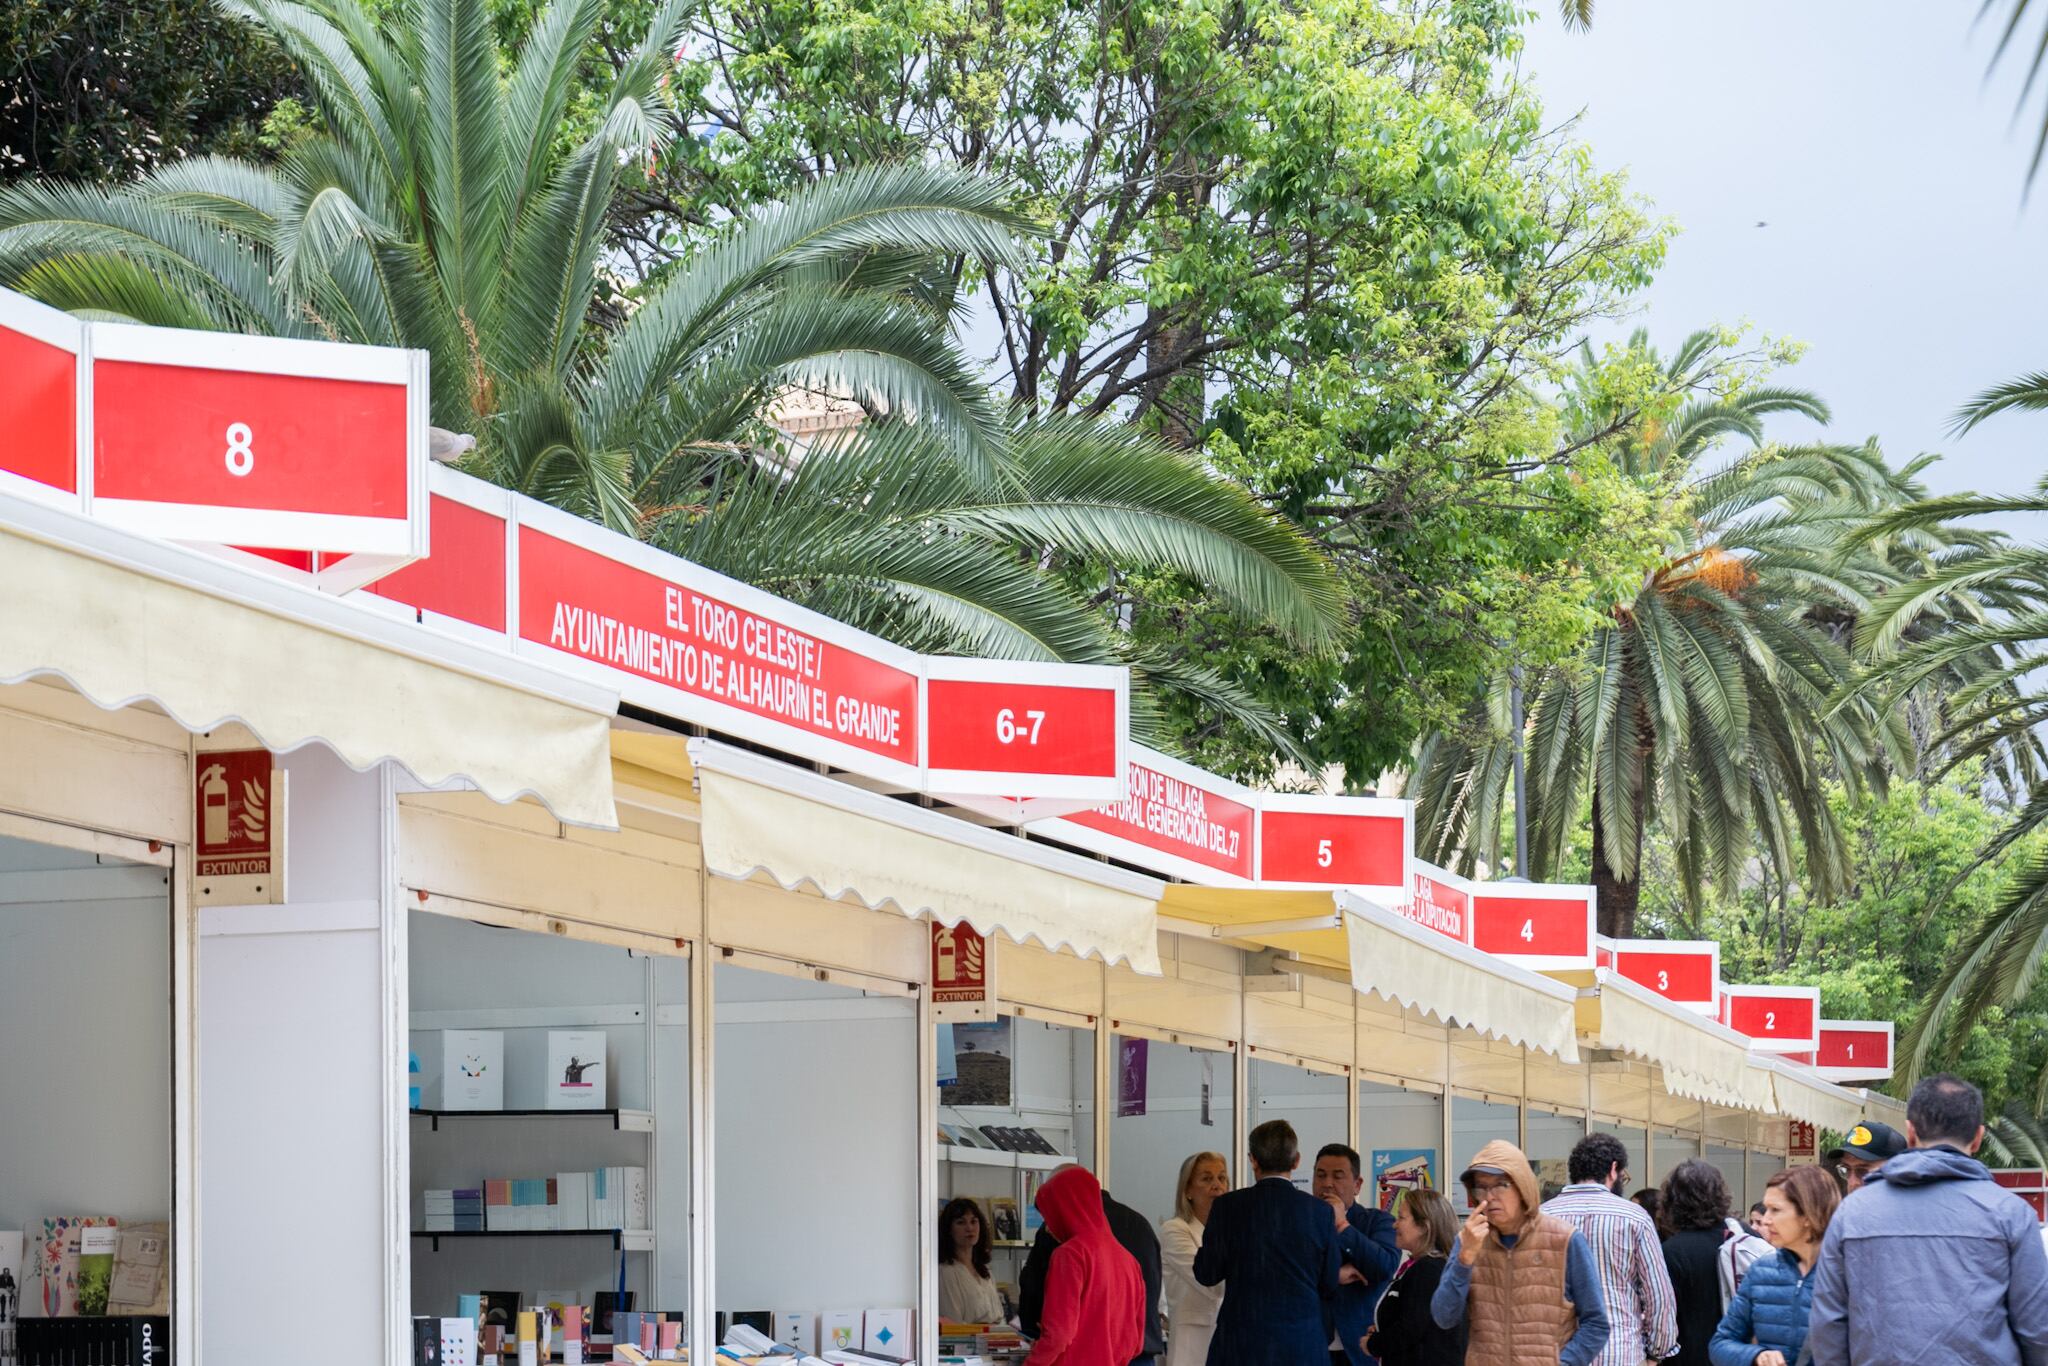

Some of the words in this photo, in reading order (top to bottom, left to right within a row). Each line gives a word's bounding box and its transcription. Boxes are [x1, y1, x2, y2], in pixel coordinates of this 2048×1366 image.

[225, 421, 254, 476] 8
[665, 586, 689, 633] EL
[692, 596, 739, 650] TORO
[743, 616, 814, 677] CELESTE
[551, 601, 698, 687] AYUNTAMIENTO
[701, 649, 724, 696] DE
[727, 660, 810, 722] ALHAURÍN
[813, 687, 833, 729] EL
[835, 695, 900, 746] GRANDE
[996, 708, 1046, 745] 6-7
[1150, 771, 1164, 805] DE
[1209, 821, 1228, 855] DEL
[1228, 829, 1240, 860] 27
[1318, 839, 1332, 868] 5
[202, 861, 267, 875] EXTINTOR
[1520, 918, 1534, 942] 4
[1657, 970, 1669, 991] 3
[936, 991, 983, 1001] EXTINTOR
[1765, 1011, 1776, 1030] 2
[1846, 1043, 1854, 1060] 1
